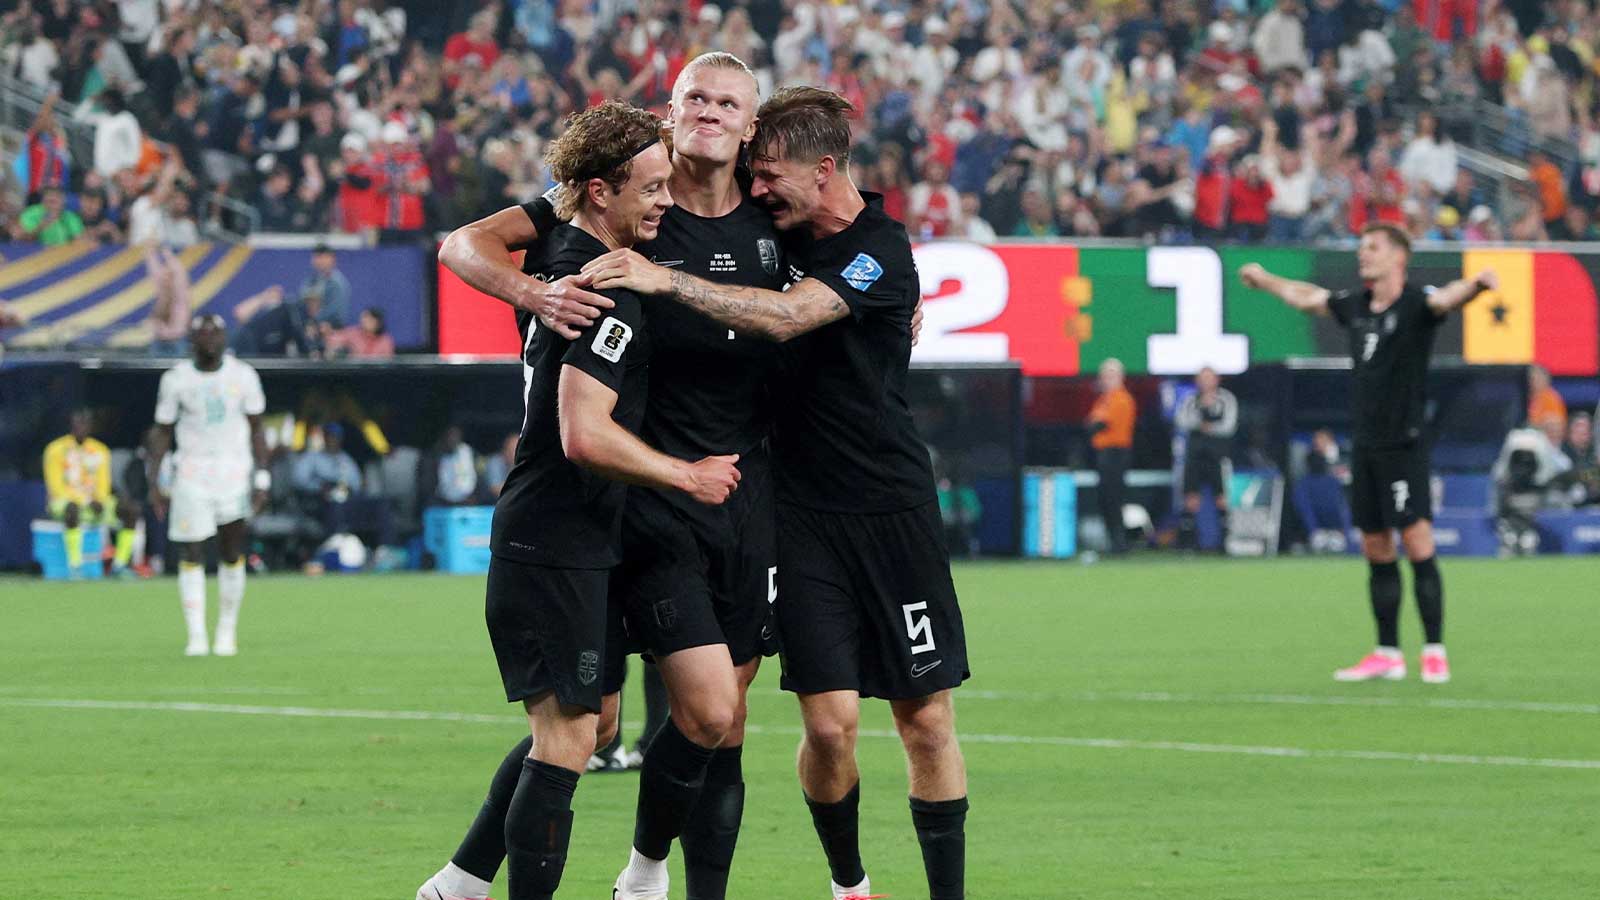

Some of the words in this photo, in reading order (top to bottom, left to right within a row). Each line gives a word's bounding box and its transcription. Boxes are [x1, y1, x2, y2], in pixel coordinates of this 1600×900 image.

[908, 242, 1010, 362] 2
[1146, 246, 1250, 375] 1
[1362, 332, 1379, 362] 7
[1391, 479, 1411, 513] 7
[902, 600, 936, 655] 5
